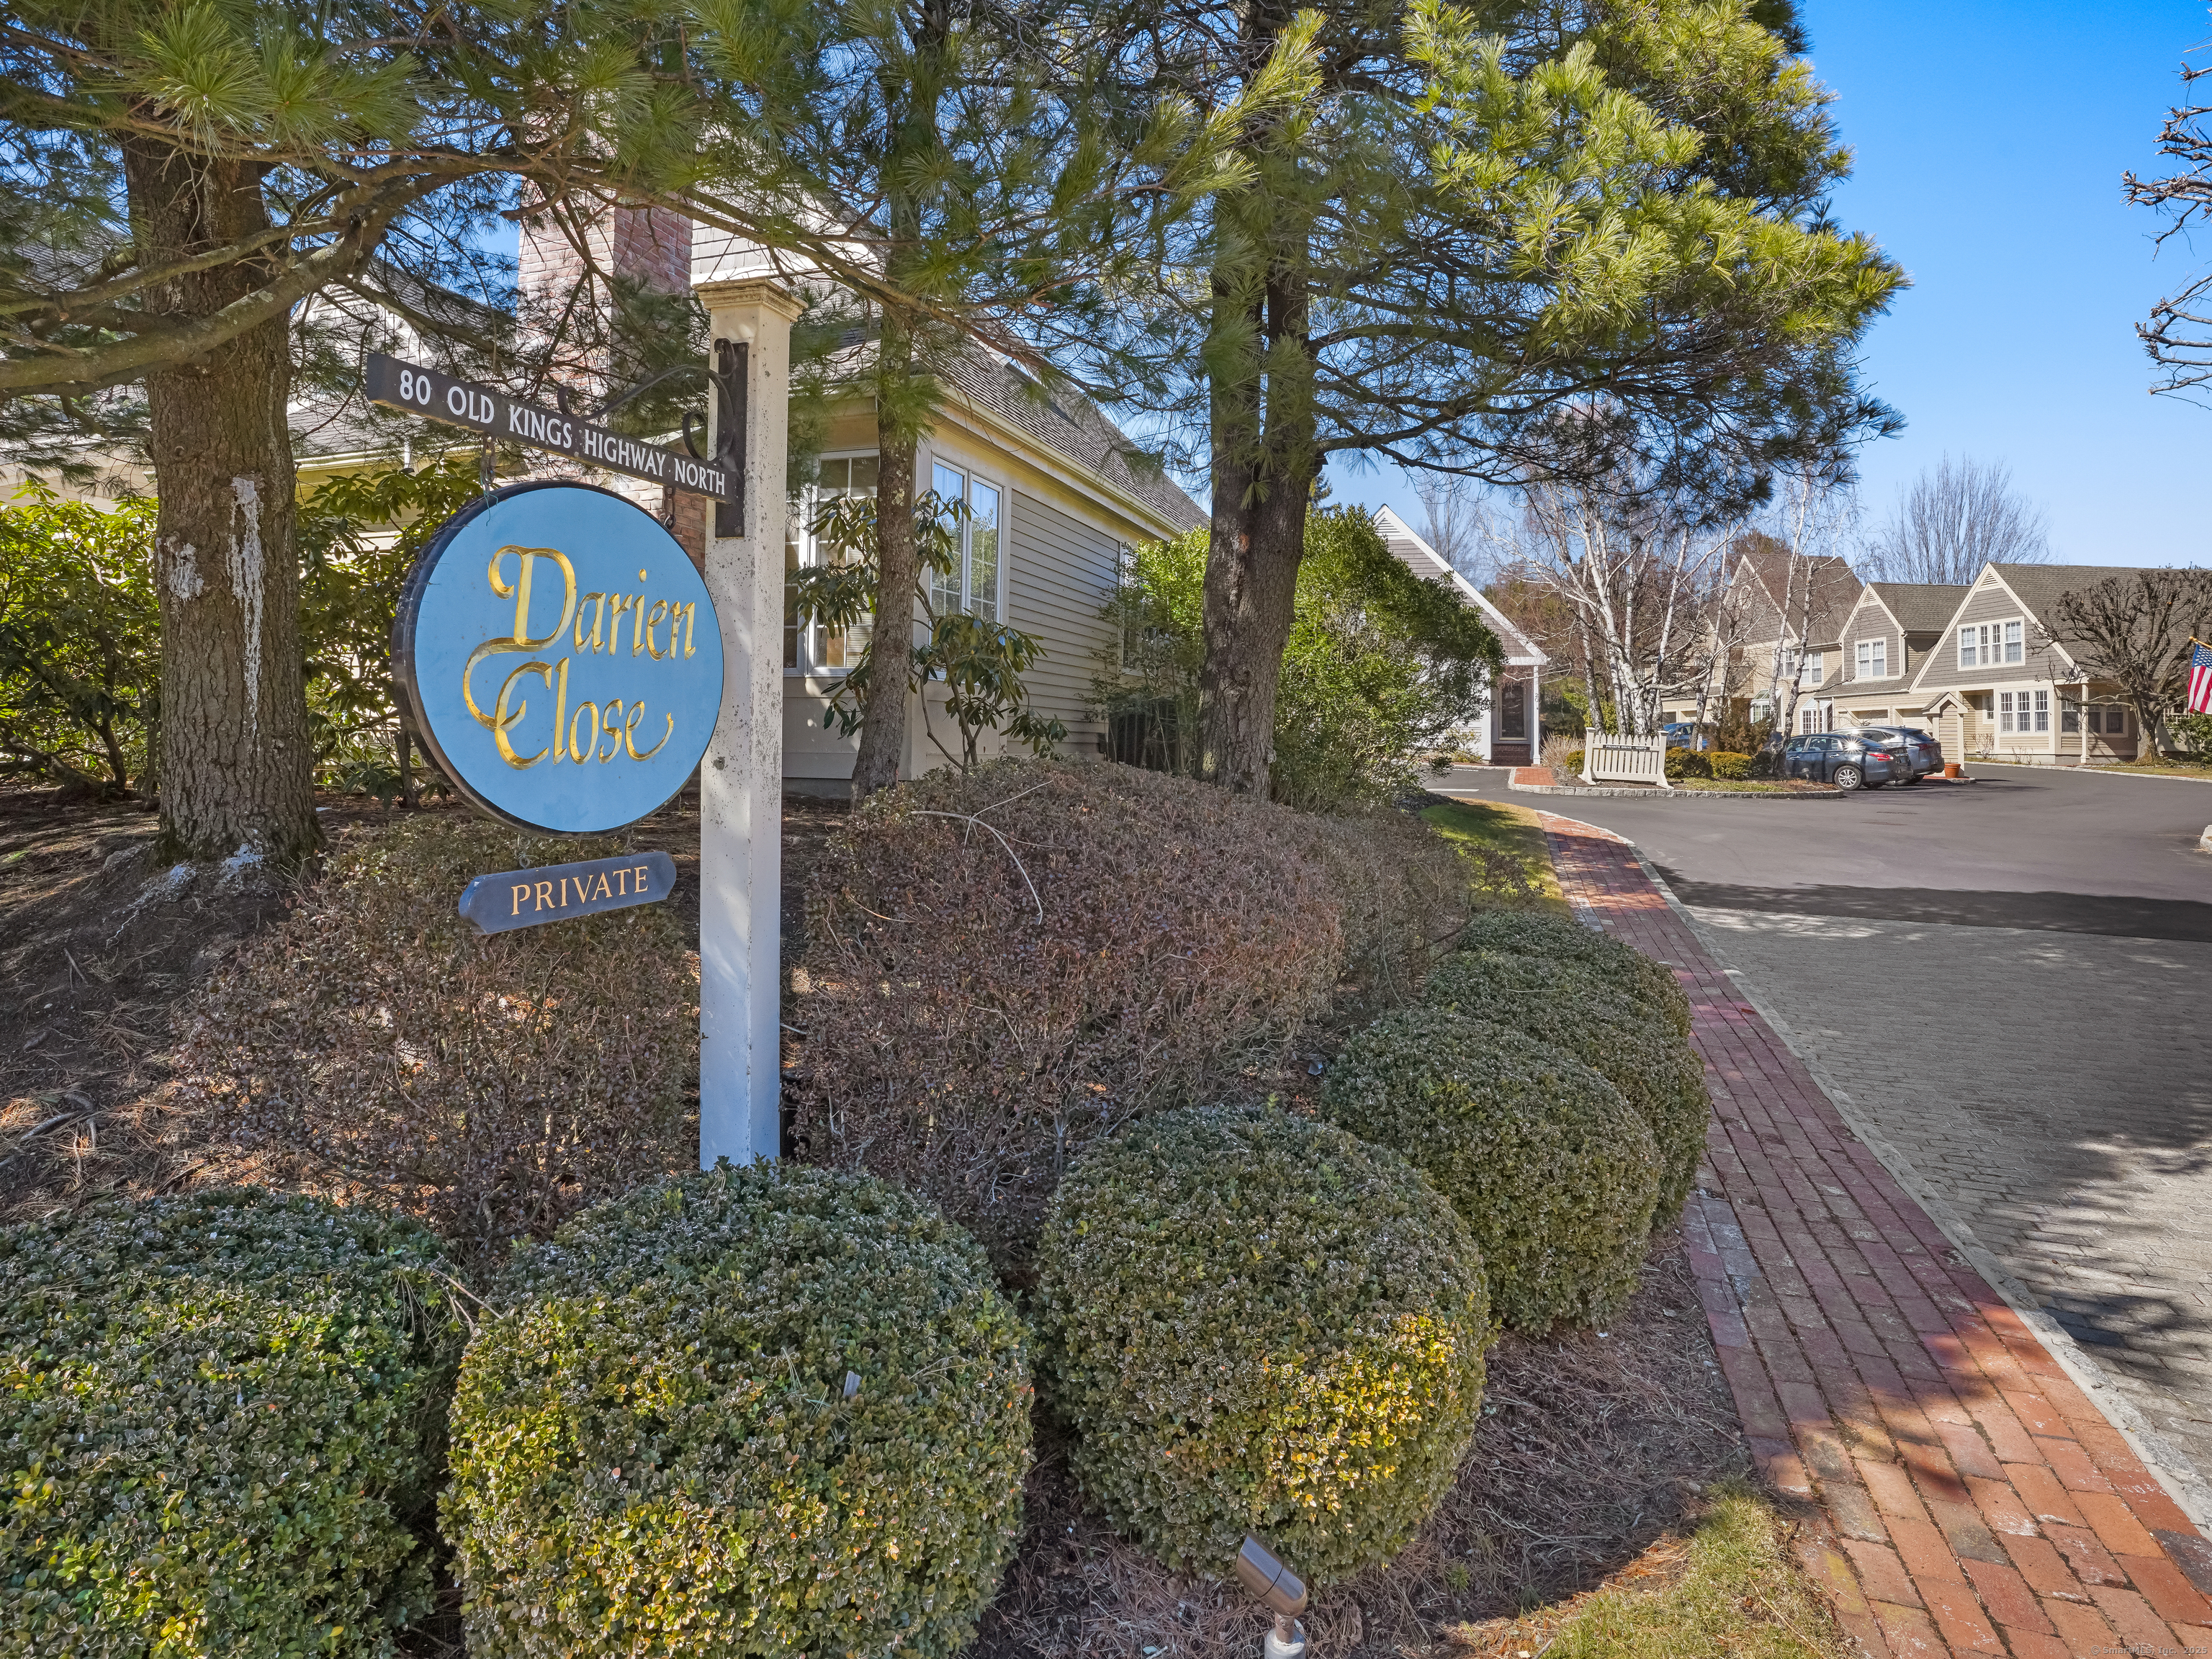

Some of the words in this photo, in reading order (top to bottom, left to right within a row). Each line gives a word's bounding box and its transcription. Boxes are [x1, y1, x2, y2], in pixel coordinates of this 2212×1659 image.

[400, 369, 431, 405] 80
[447, 386, 495, 423] OLD
[508, 404, 572, 449] KINGS
[585, 428, 666, 477] HIGHWAY
[674, 458, 725, 495] NORTH
[487, 544, 696, 661] Darien
[463, 657, 674, 770] Close
[511, 866, 649, 915] PRIVATE
